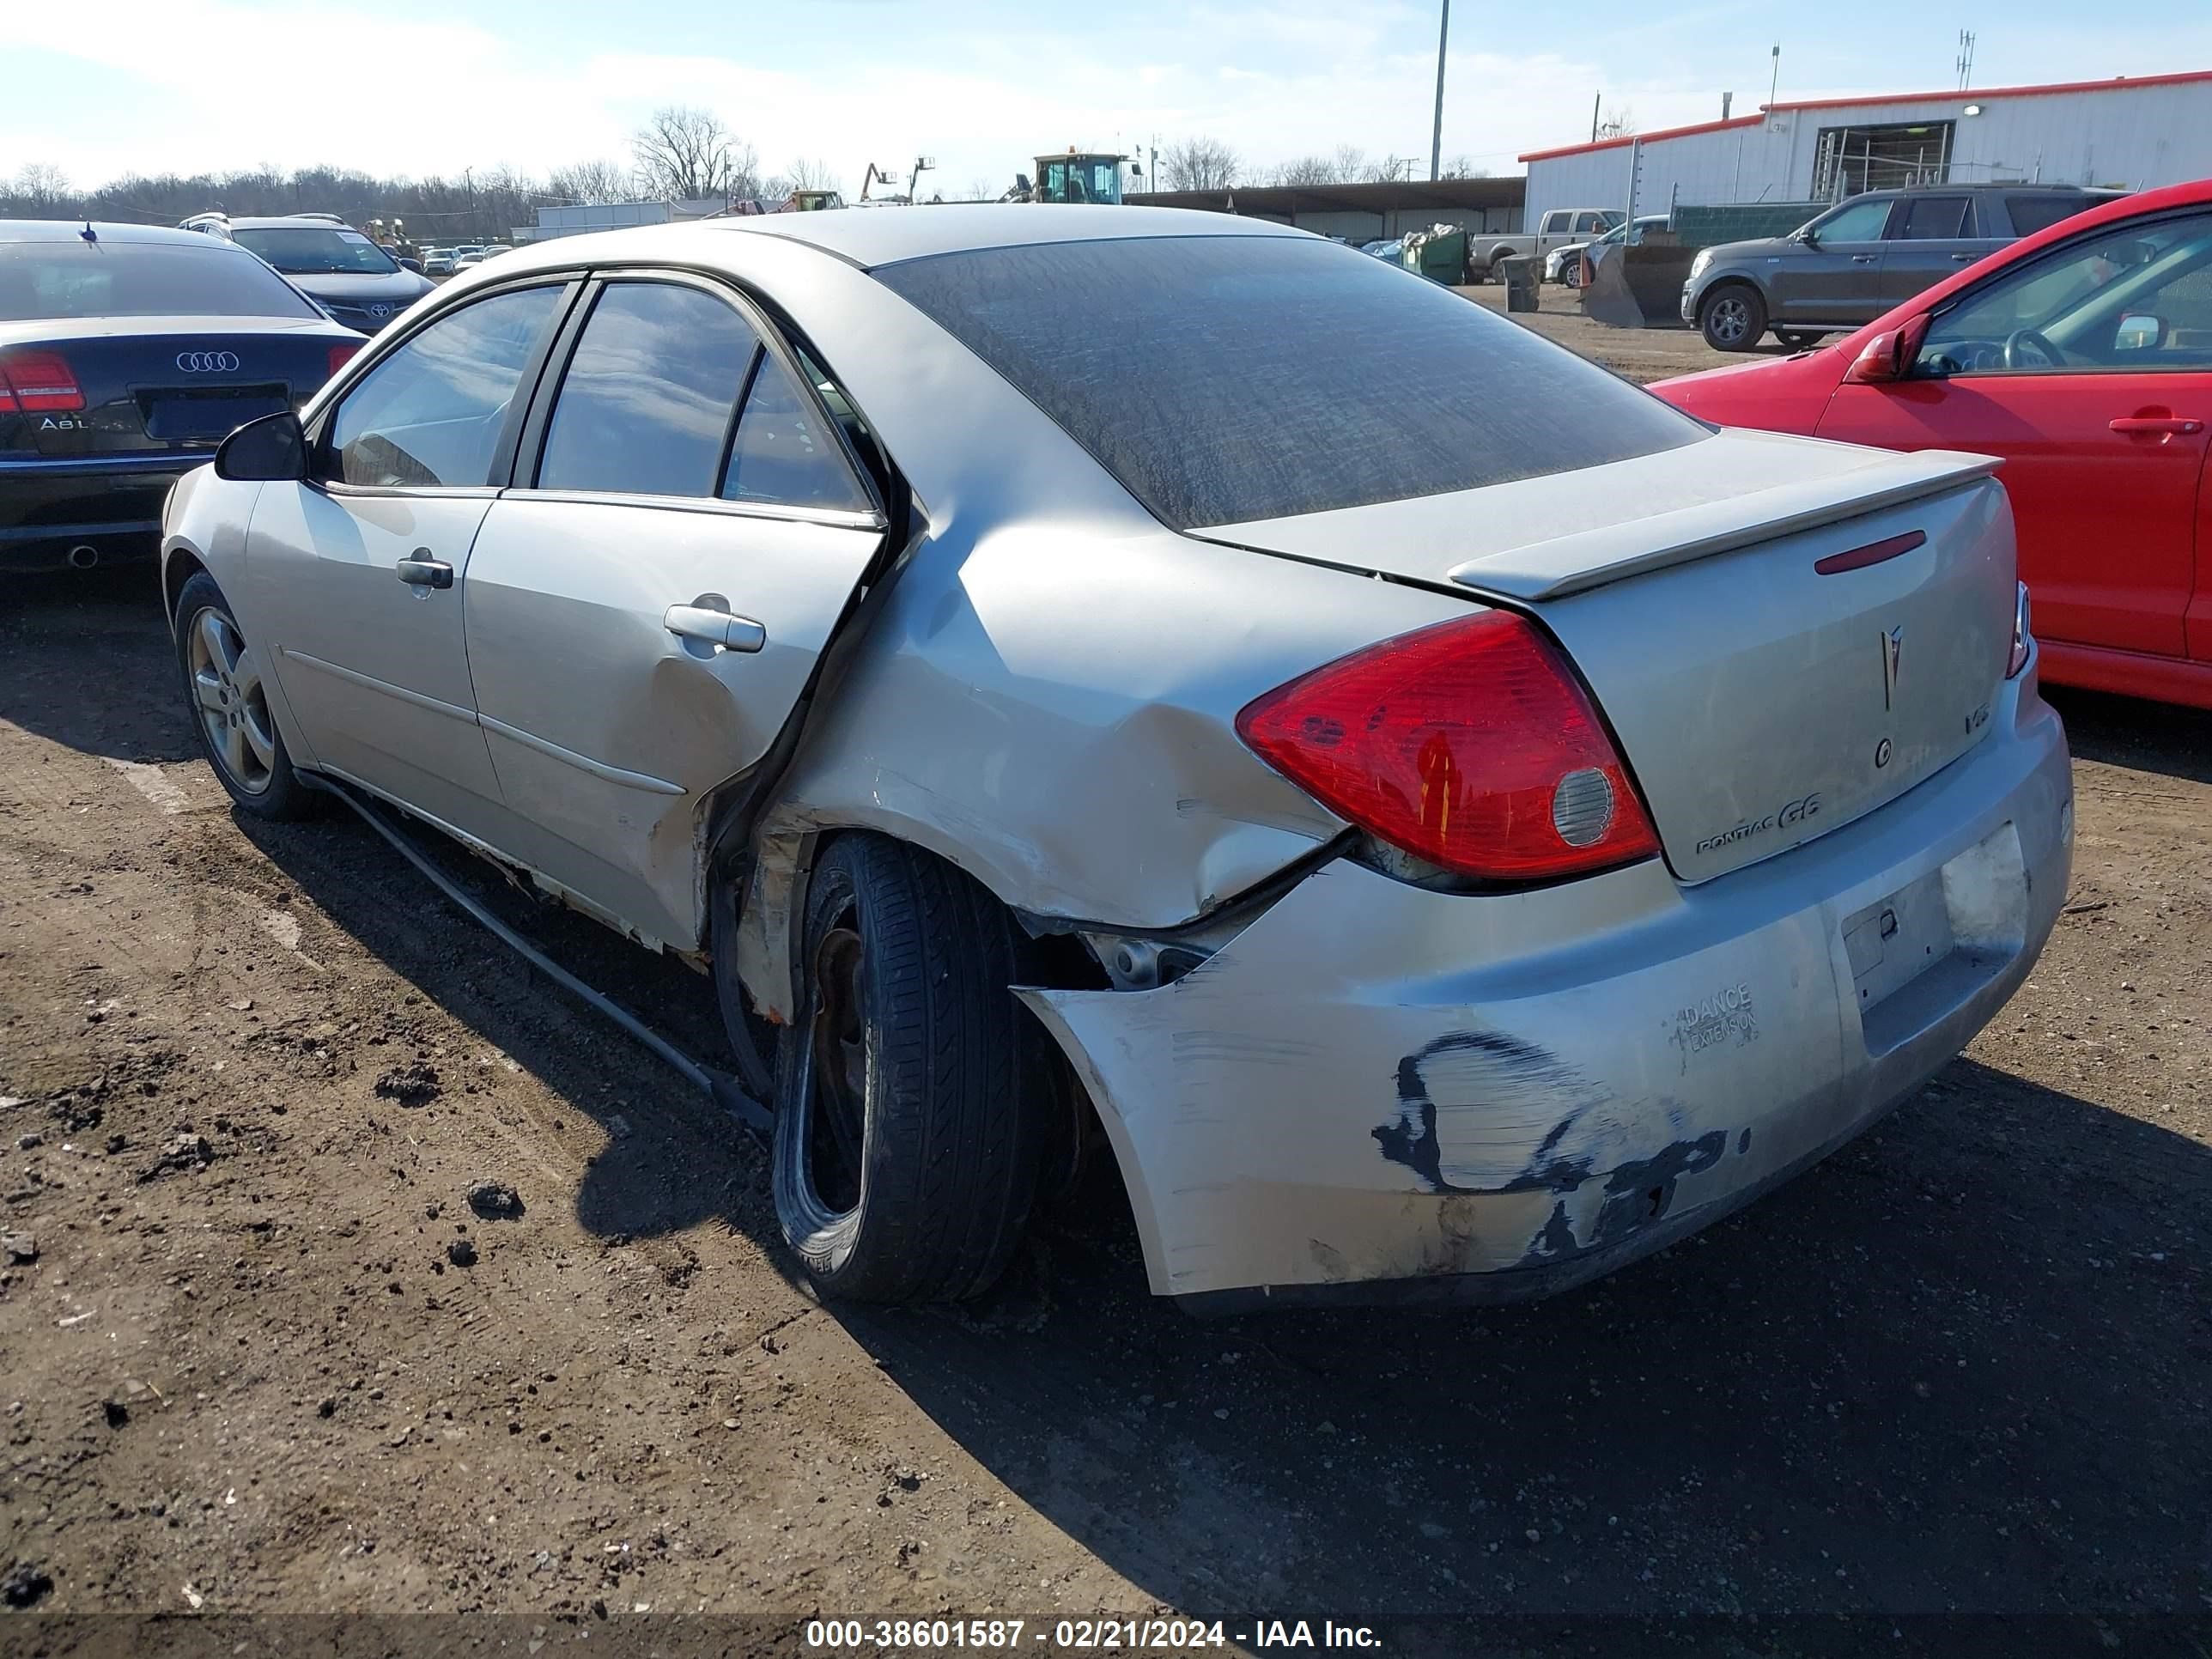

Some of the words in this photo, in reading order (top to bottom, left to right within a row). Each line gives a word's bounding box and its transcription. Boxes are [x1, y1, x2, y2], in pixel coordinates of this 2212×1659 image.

[1696, 816, 1773, 854] PONTIAC
[1778, 792, 1822, 829] G6
[1684, 981, 1752, 1028] DANCE
[1688, 1012, 1758, 1053] EXTENSION
